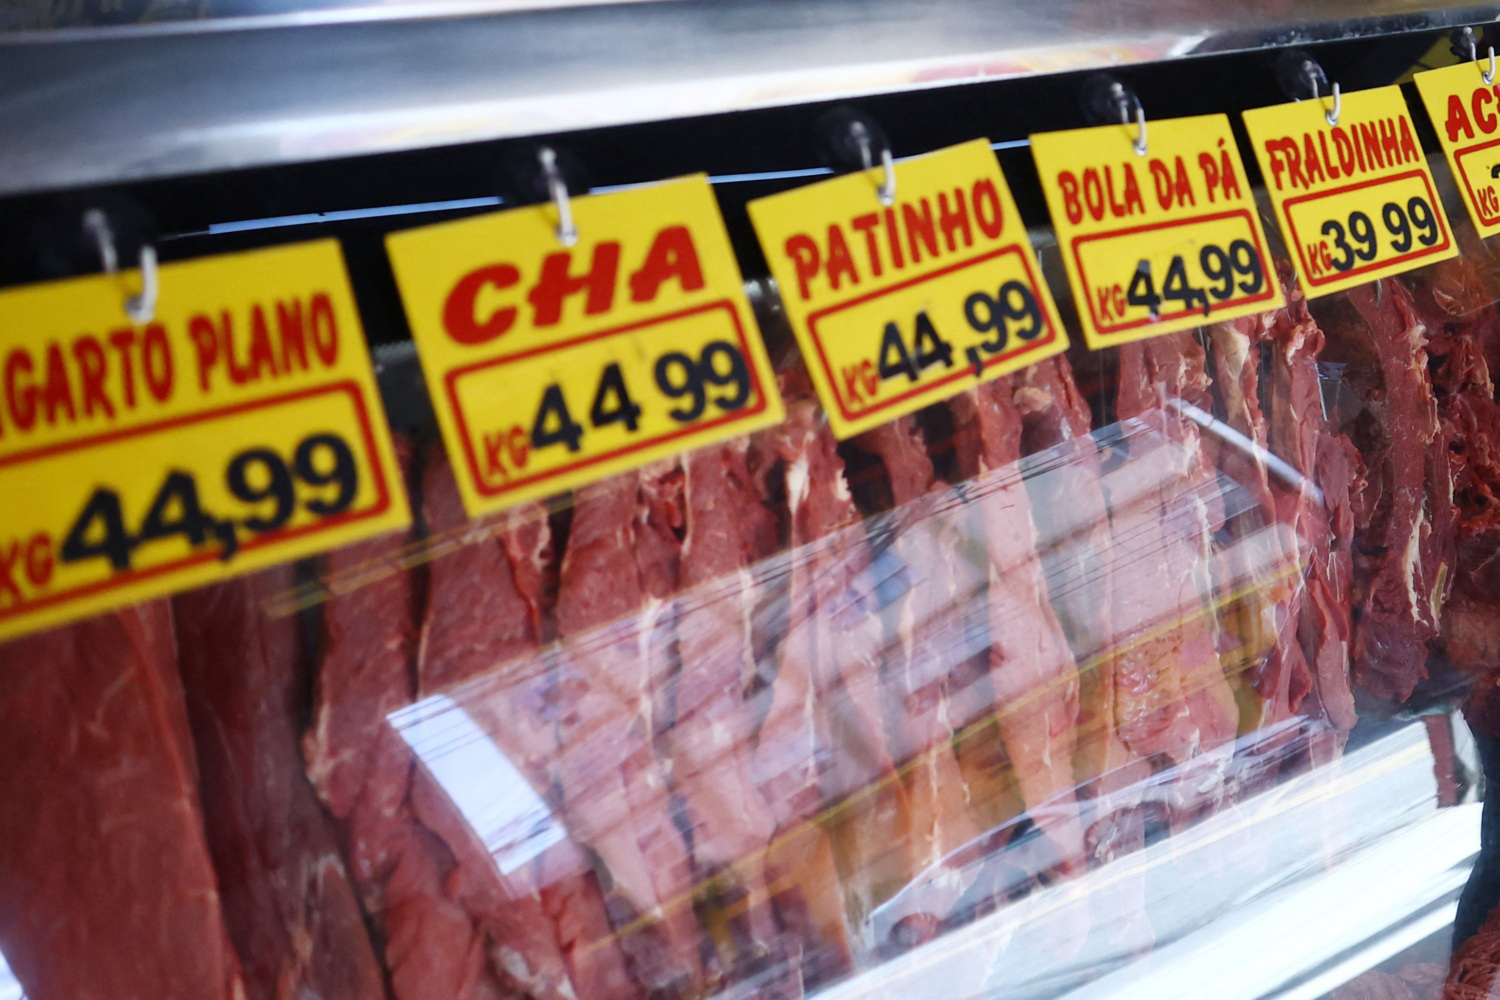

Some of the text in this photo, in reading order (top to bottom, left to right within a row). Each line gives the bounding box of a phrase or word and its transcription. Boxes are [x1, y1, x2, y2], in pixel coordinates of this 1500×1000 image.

[1058, 137, 1242, 225] BOLA DA PÁ
[1264, 114, 1420, 191] FRALDINHA
[784, 178, 1004, 300] PATINHO
[1477, 185, 1499, 218] KG
[1097, 238, 1264, 323] KG 44,99
[1306, 241, 1334, 276] KG
[0, 291, 341, 440] GARTO PLANO
[842, 279, 1044, 408] KG 44,99
[483, 424, 531, 483] KG
[0, 432, 360, 591] KG 44,99
